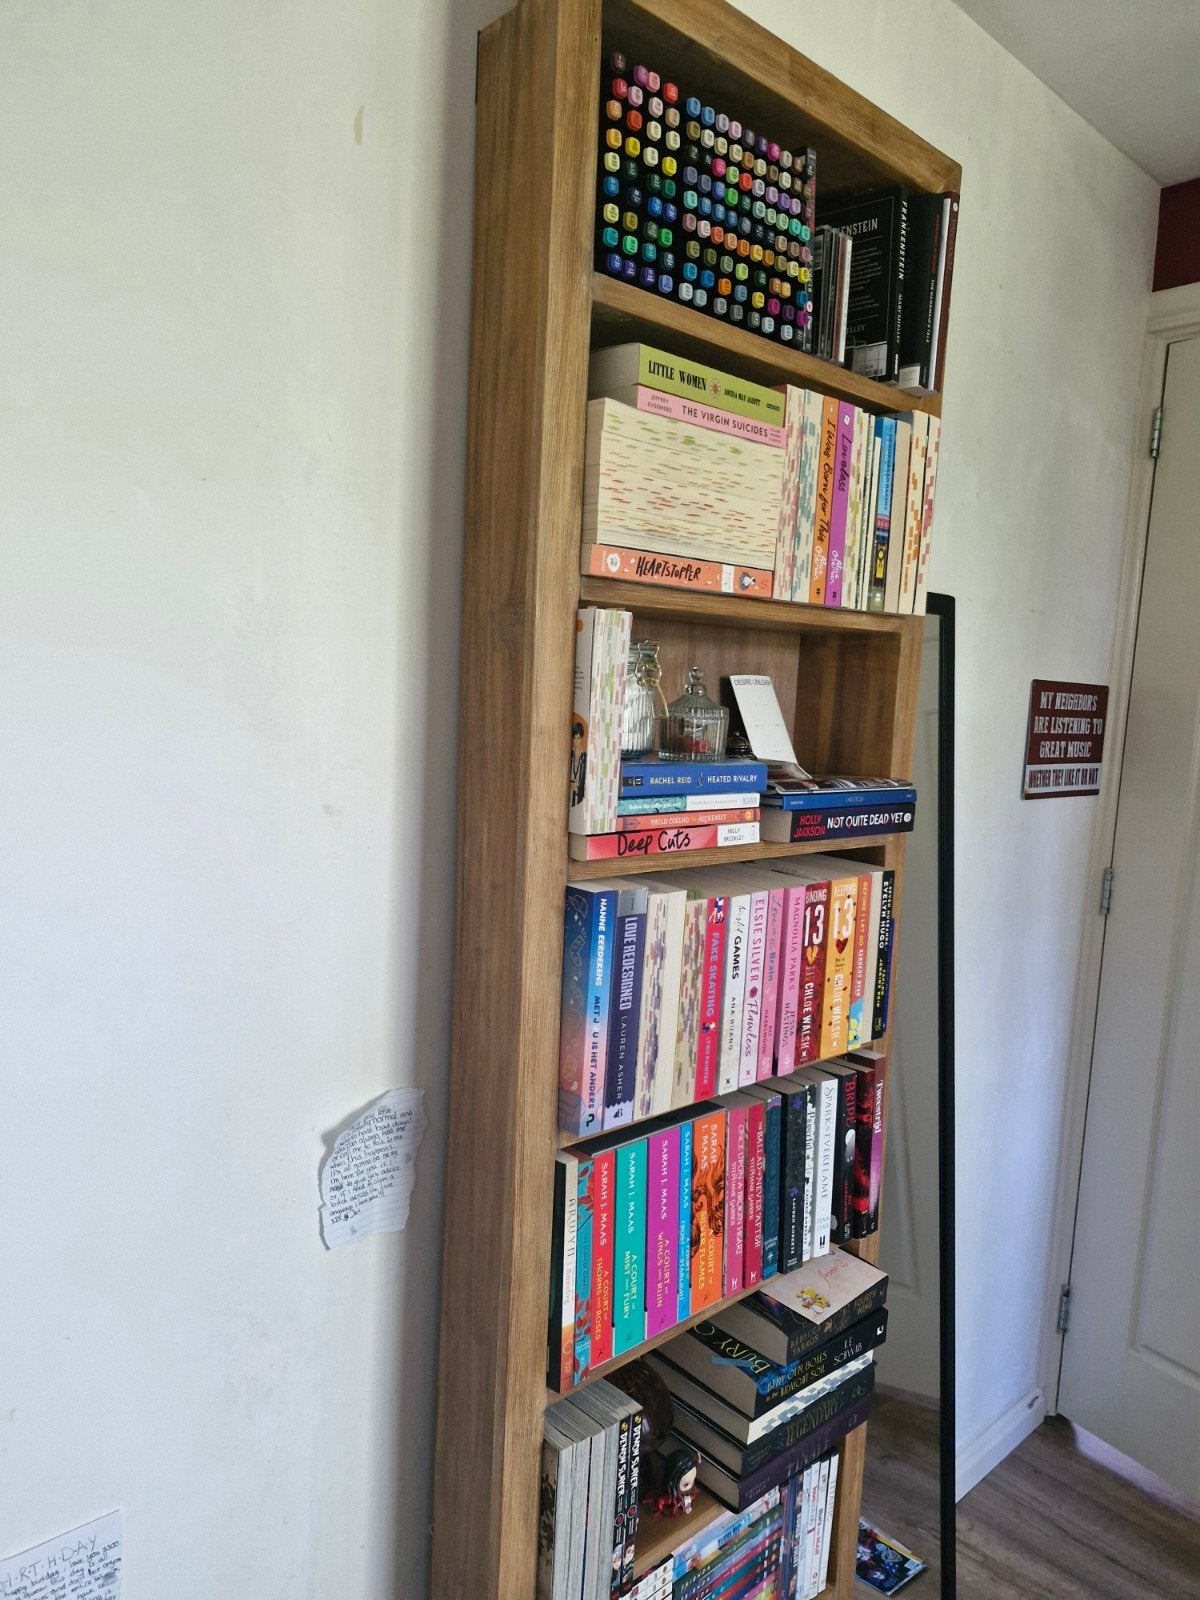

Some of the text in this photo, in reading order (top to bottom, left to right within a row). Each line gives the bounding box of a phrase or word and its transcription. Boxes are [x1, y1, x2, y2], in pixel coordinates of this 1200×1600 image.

[898, 200, 908, 280] FRANKENSTEIN
[648, 360, 707, 391] LITTLE WOMEN
[651, 394, 668, 403] JEFFREY
[682, 405, 698, 418] THE
[700, 411, 730, 426] VIRGIN
[732, 420, 768, 437] SUICIDES
[838, 434, 852, 492] Loveless
[817, 418, 836, 543] I Was Born for This
[636, 556, 701, 582] HEARTSTOPPER
[1040, 691, 1098, 711] MY NEIGHBORS
[1034, 716, 1103, 734] ARE LISTENING TO
[1040, 741, 1092, 758] GREAT MUSIC
[650, 776, 692, 785] RACHEL REID
[707, 774, 758, 783] HEATED RIVALRY
[1029, 769, 1051, 788] WHETHER
[1052, 769, 1063, 787] THEY
[1064, 768, 1074, 786] LIKE
[1088, 768, 1099, 786] NOT
[794, 826, 826, 838] JACKSON
[800, 815, 822, 824] HOLLY
[827, 812, 903, 829] NOT QUITE DEAD YET
[616, 830, 691, 856] Deep Cuts
[805, 888, 827, 902] BINDING
[834, 882, 856, 898] KEEPING
[804, 905, 825, 947] 13
[833, 898, 855, 939] 13
[595, 898, 608, 986] HANNE EERDEKENS
[750, 899, 764, 982] ELSIE SILVER
[788, 897, 800, 991] MAGNOLIA PARKS
[858, 934, 864, 946] GO
[619, 917, 638, 1010] LOVE REDESIGNED
[706, 932, 720, 1017] FAKE SKATING
[732, 936, 742, 980] GAMES
[767, 952, 776, 982] Brain
[802, 982, 813, 1013] CHLOE
[833, 974, 843, 1004] CHLOE
[744, 999, 758, 1058] Flawless
[782, 1002, 790, 1048] HASTINGS
[800, 1014, 810, 1048] WALSH
[830, 1006, 841, 1039] WALSH
[588, 995, 602, 1109] MET IS HET ANDERS
[616, 1015, 628, 1100] LAUREN ASHER
[845, 1077, 857, 1127] BRIDE
[873, 1079, 884, 1134] Tweestrijd
[701, 1135, 709, 1170] MAAS
[710, 1124, 718, 1164] SARAH
[821, 1086, 835, 1200] SPARK EVERFLAME
[682, 1130, 691, 1209] SARAH MAAS
[736, 1152, 744, 1179] UPON
[599, 1162, 608, 1246] SARAH MAAS
[627, 1152, 636, 1234] SARAH MAAS
[660, 1189, 668, 1220] MAAS
[754, 1176, 762, 1212] NEVER
[735, 1226, 743, 1256] HEART
[622, 1250, 631, 1319] MIST FURY
[698, 1249, 706, 1290] FLAMES
[656, 1283, 664, 1307] RUIN
[720, 1338, 772, 1374] BURY
[619, 1432, 628, 1463] DEMON
[630, 1425, 641, 1490] DEMON SLAYER
[617, 1465, 626, 1498] SLAYER
[70, 1568, 84, 1578] day
[99, 1552, 108, 1563] all
[87, 1550, 100, 1562] you
